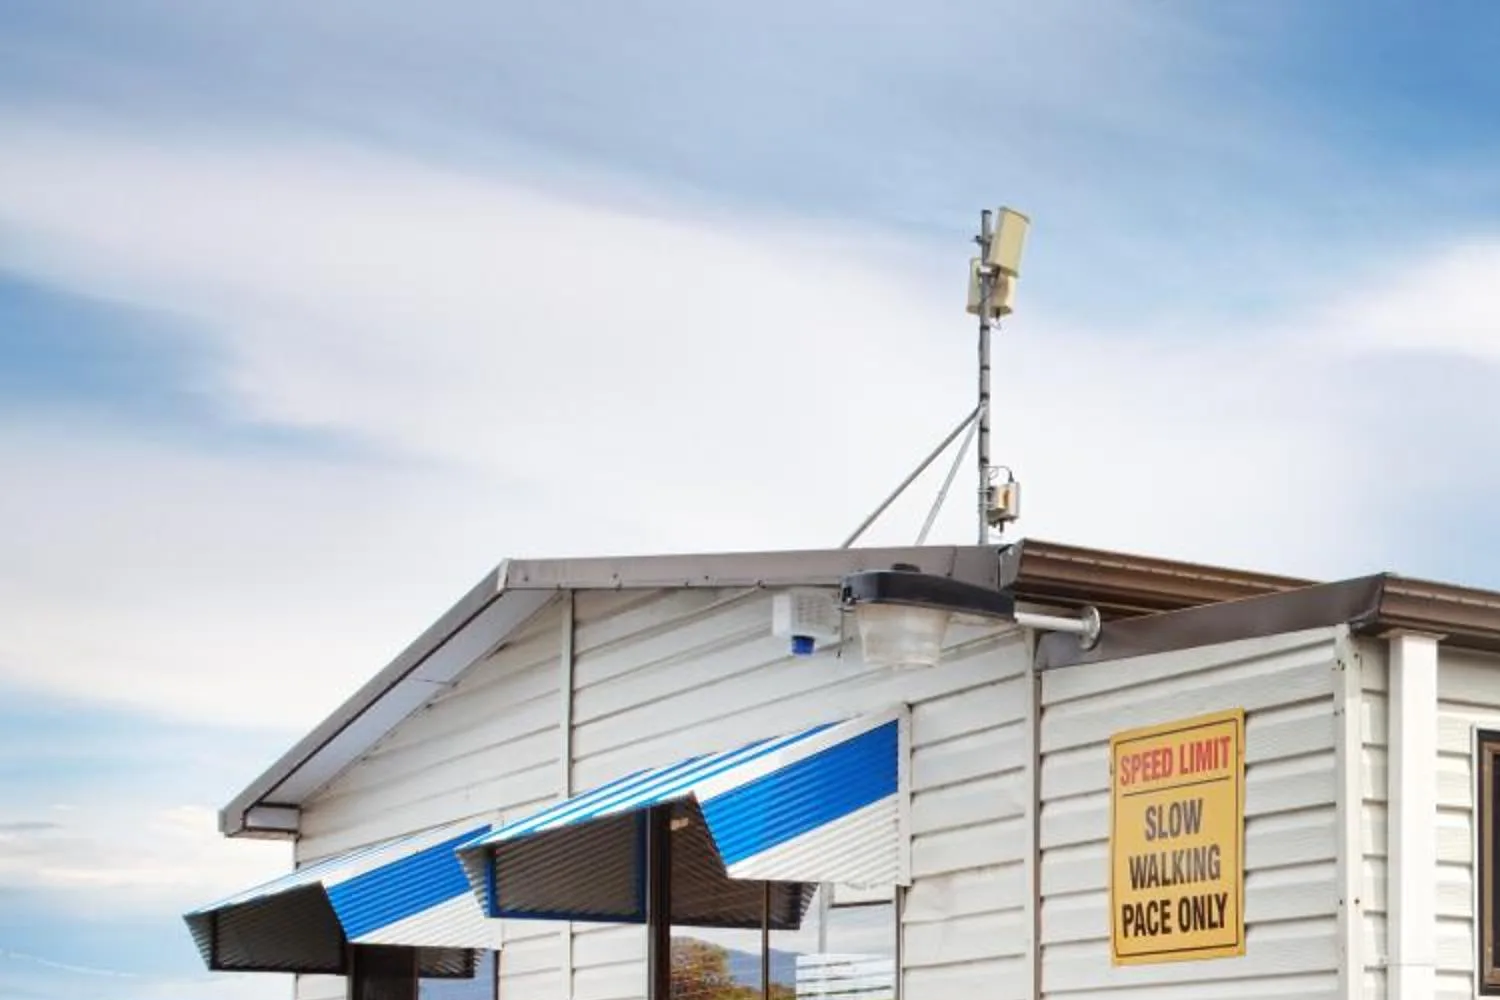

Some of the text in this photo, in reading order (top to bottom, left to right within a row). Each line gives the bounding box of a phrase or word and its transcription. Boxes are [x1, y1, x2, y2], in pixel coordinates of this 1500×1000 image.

[1121, 736, 1231, 787] SPEED LIMIT
[1145, 798, 1203, 841] SLOW
[1129, 844, 1221, 890] WALKING
[1122, 892, 1228, 939] PACE ONLY
